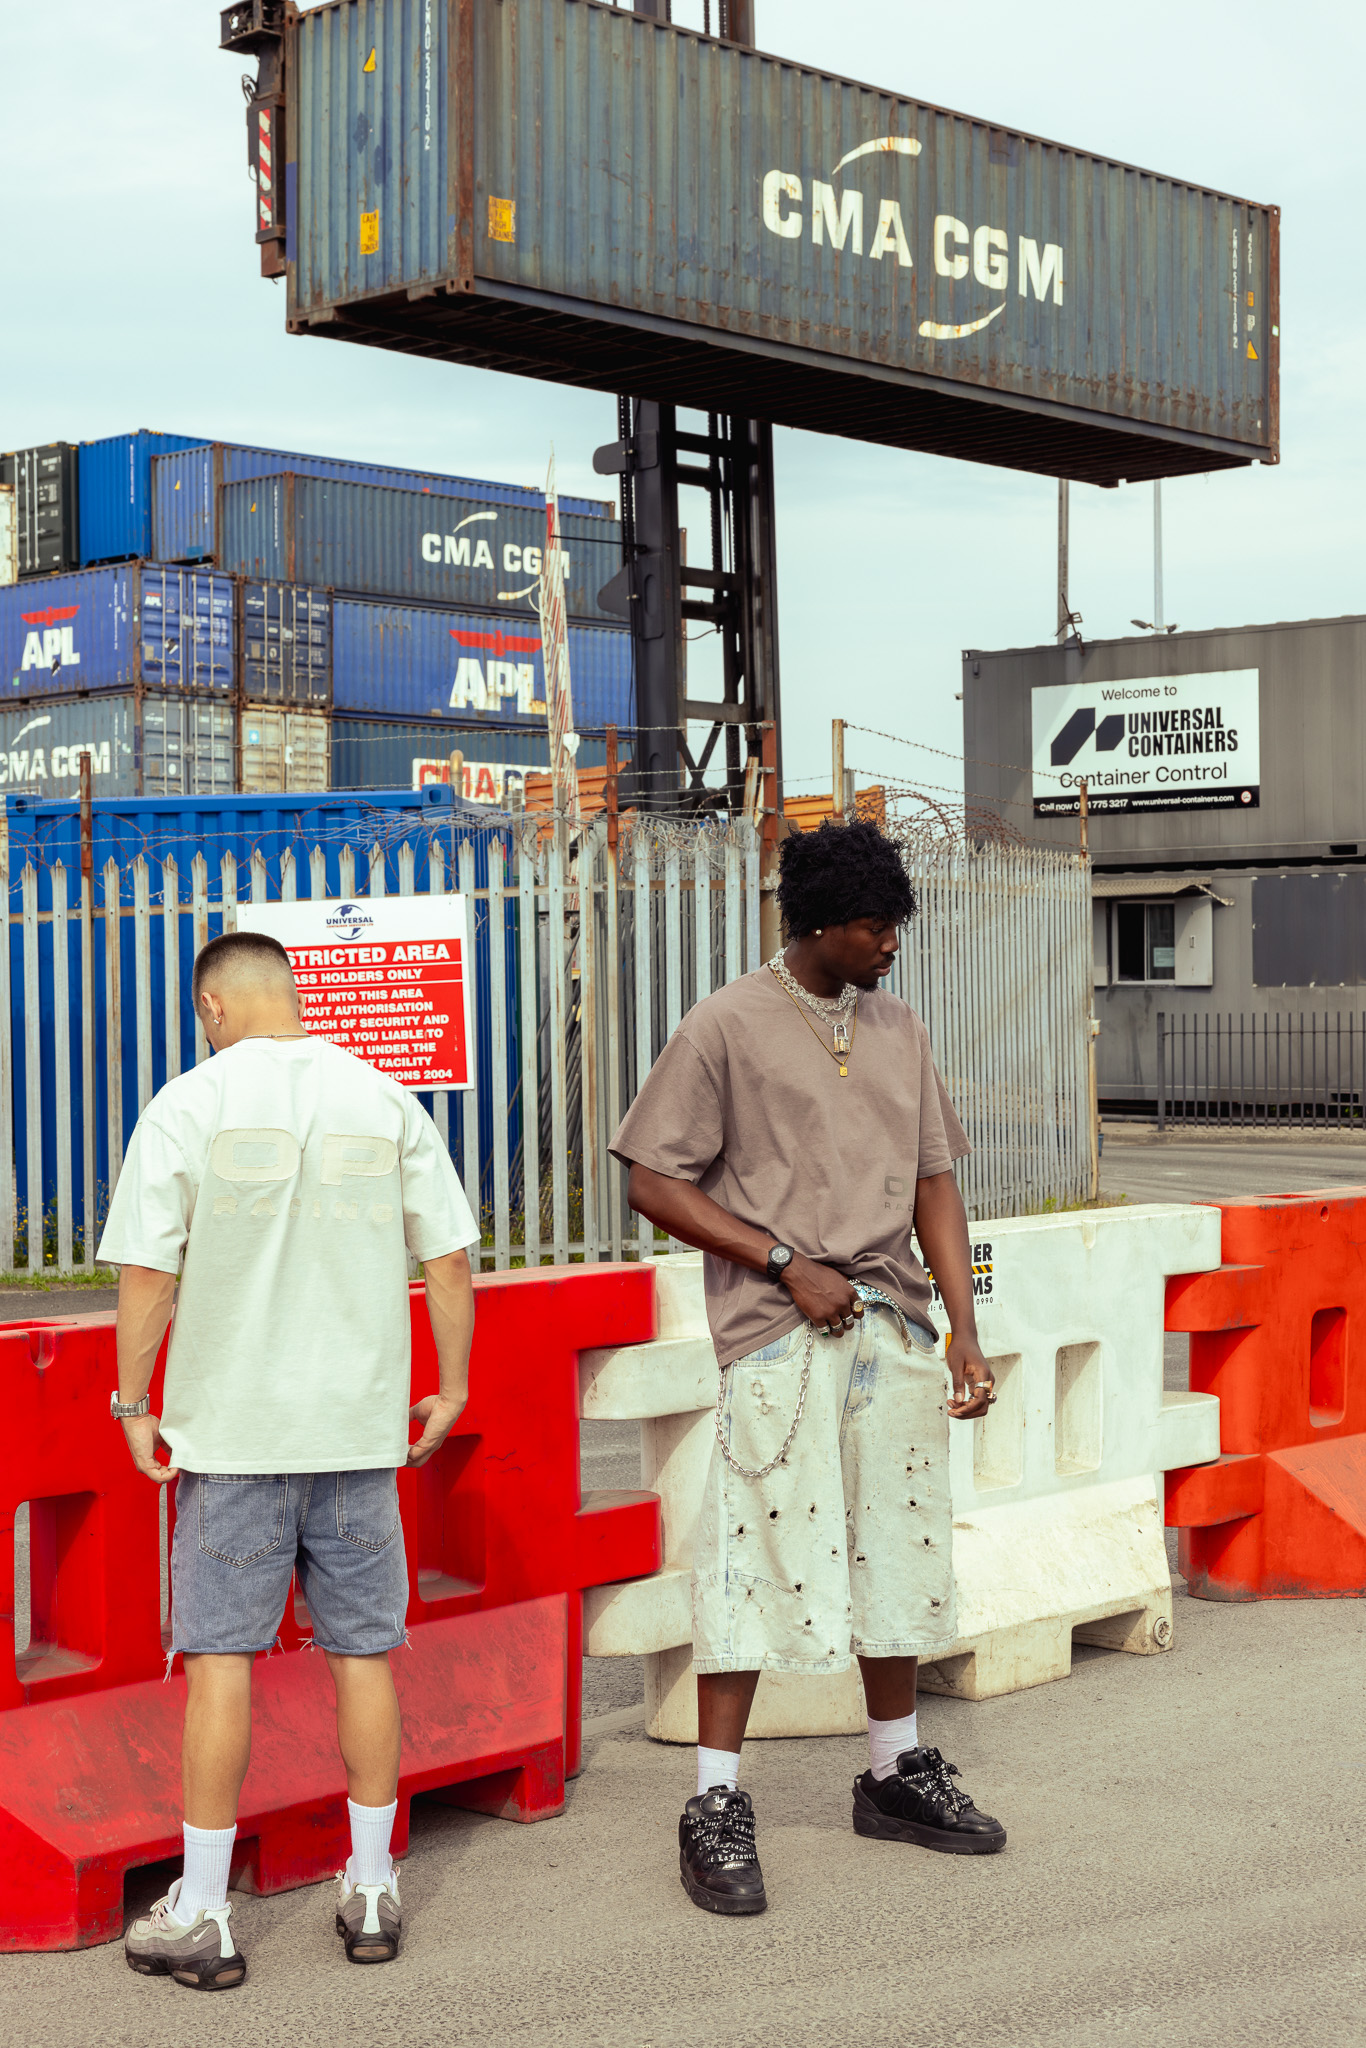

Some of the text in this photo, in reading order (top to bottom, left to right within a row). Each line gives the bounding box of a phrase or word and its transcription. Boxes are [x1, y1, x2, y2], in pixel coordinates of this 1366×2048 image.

[763, 169, 1065, 306] CMA CGM
[422, 533, 495, 570] CMA
[21, 626, 81, 671] APL
[449, 657, 547, 715] APL
[1102, 685, 1177, 701] Welcome to
[1128, 707, 1224, 734] UNIVERSAL
[1128, 729, 1238, 757] CONTAINERS
[1060, 762, 1228, 788] Container Control
[1040, 803, 1054, 812] Call
[1056, 803, 1072, 811] now
[1109, 799, 1128, 808] 3217
[1132, 795, 1235, 807] www.universal-containers.com
[392, 943, 450, 962] AREA
[321, 970, 384, 984] HOLDERS
[387, 968, 423, 981] ONLY
[327, 991, 356, 1002] INTO
[359, 990, 388, 1000] THIS
[391, 988, 423, 999] AREA
[334, 1001, 433, 1015] AUTHORISATION
[340, 1018, 357, 1029] OF
[359, 1016, 420, 1028] SECURITY
[423, 1014, 449, 1025] AND
[352, 1032, 378, 1041] YOU
[381, 1029, 424, 1040] LIABLE
[426, 1028, 443, 1038] TO
[366, 1044, 413, 1055] UNDER
[412, 1042, 436, 1053] THE
[378, 1056, 432, 1068] FACILITY
[423, 1069, 453, 1079] 2004
[212, 1195, 394, 1223] RACING
